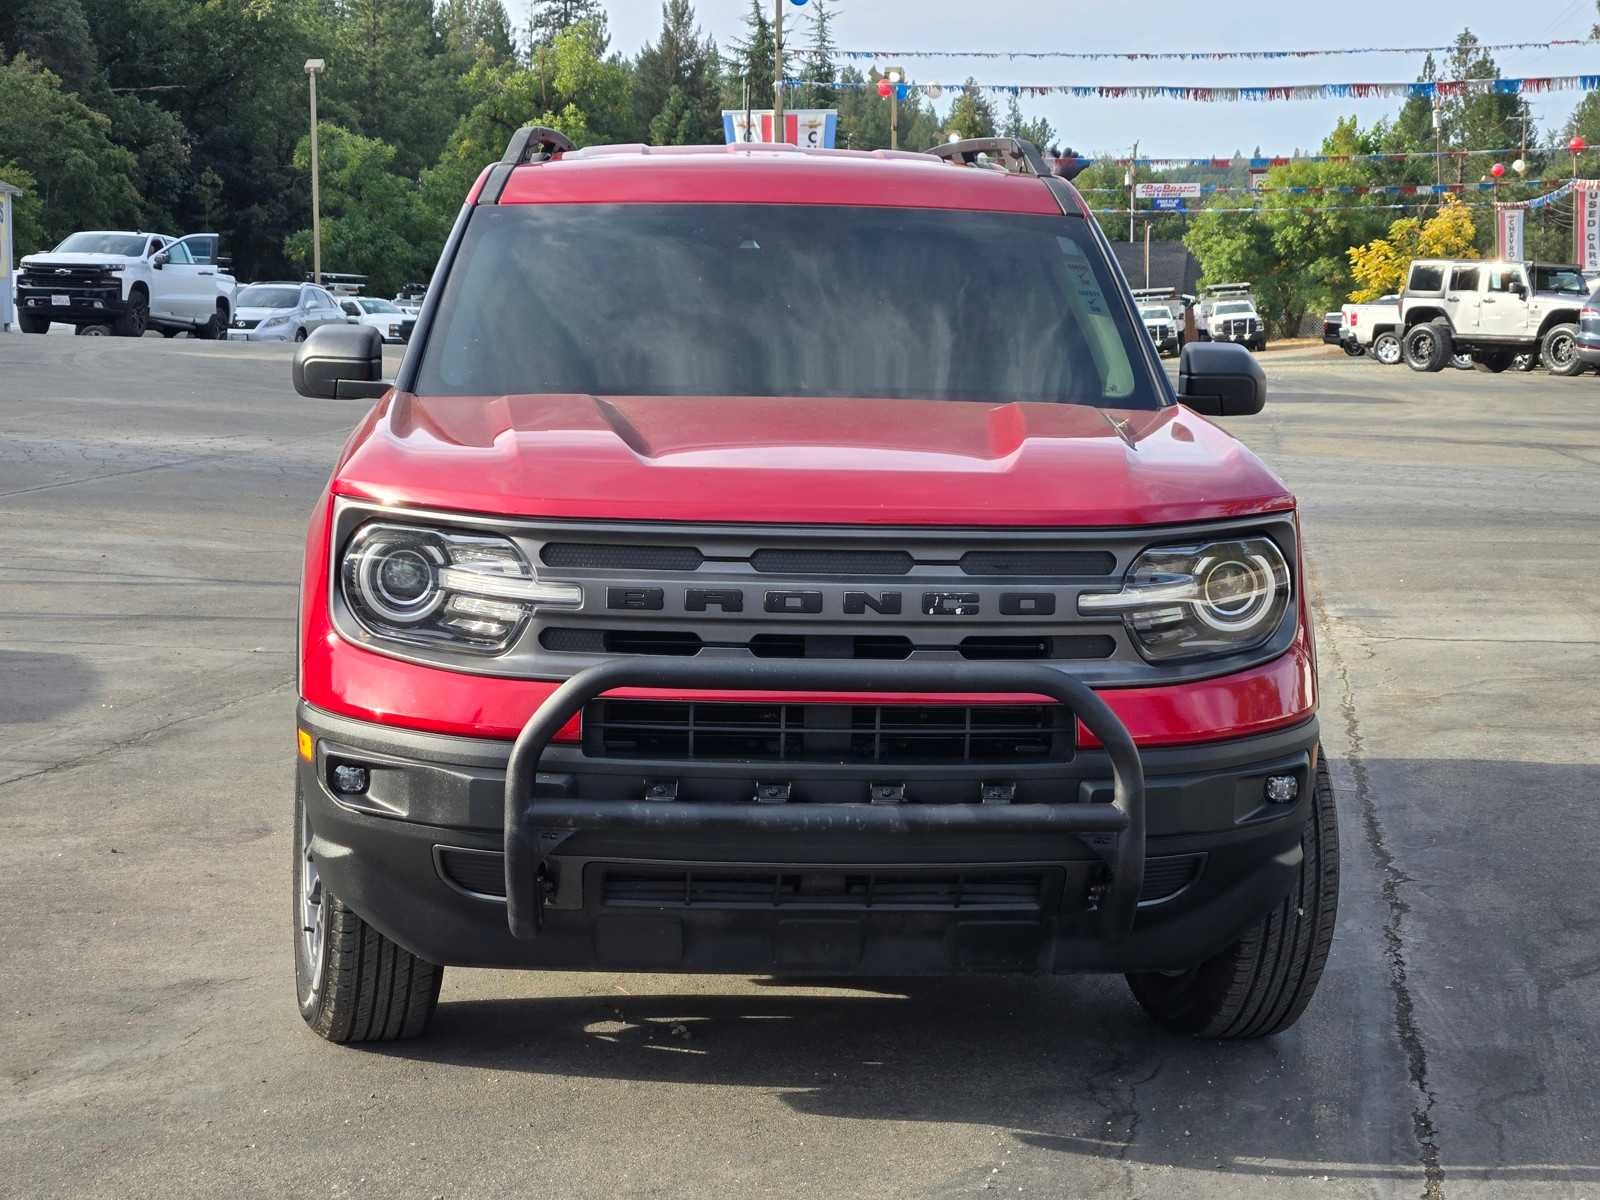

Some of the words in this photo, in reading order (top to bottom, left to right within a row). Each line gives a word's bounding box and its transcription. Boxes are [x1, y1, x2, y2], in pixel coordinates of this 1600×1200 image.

[1588, 191, 1598, 227] USED
[1587, 233, 1598, 266] CARS
[606, 586, 1056, 615] BRONCO
